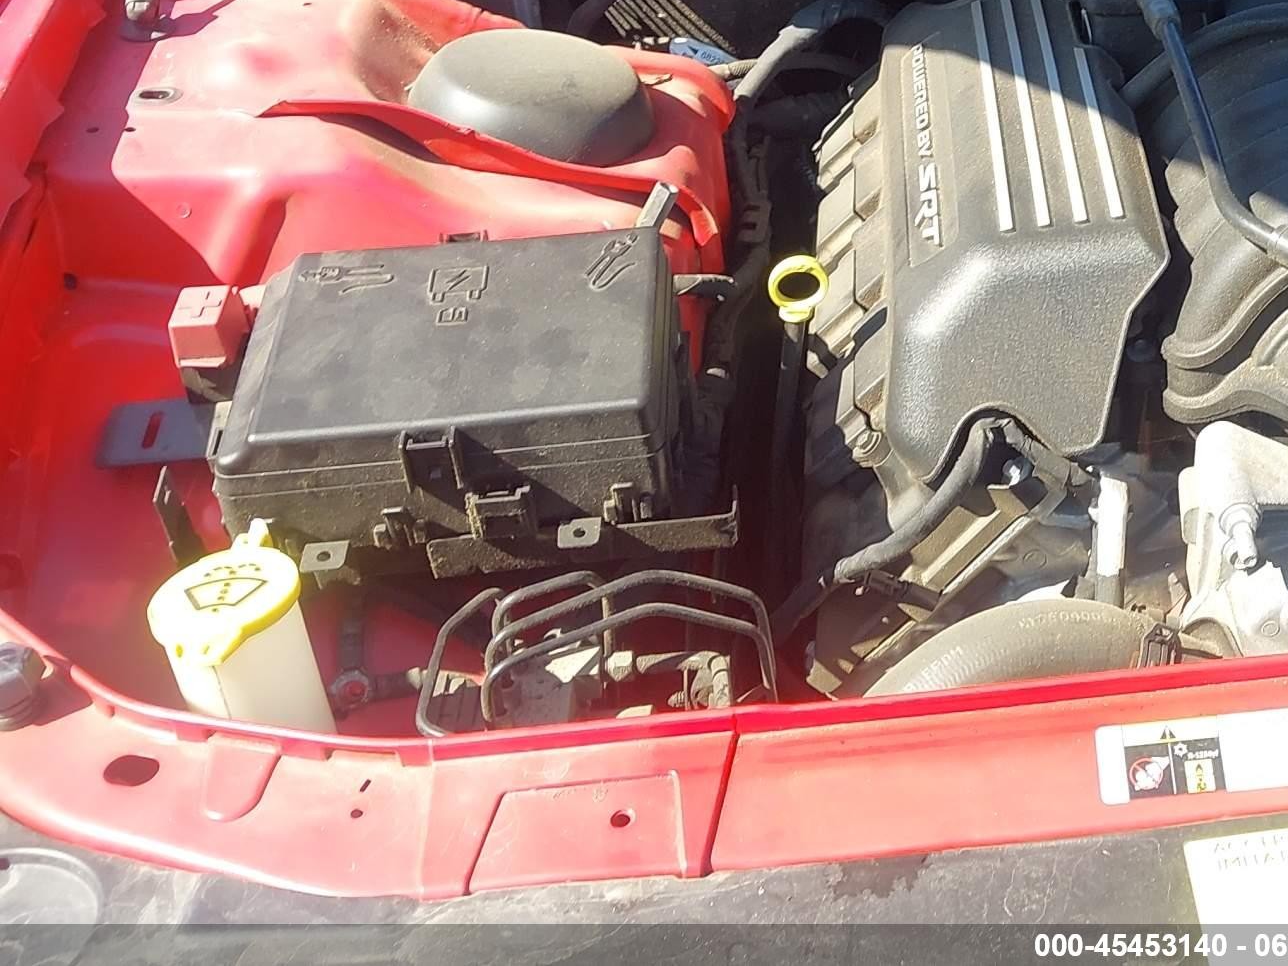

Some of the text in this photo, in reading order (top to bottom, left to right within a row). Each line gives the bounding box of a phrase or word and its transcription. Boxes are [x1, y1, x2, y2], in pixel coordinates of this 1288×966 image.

[911, 44, 942, 247] POWERED BY SRT
